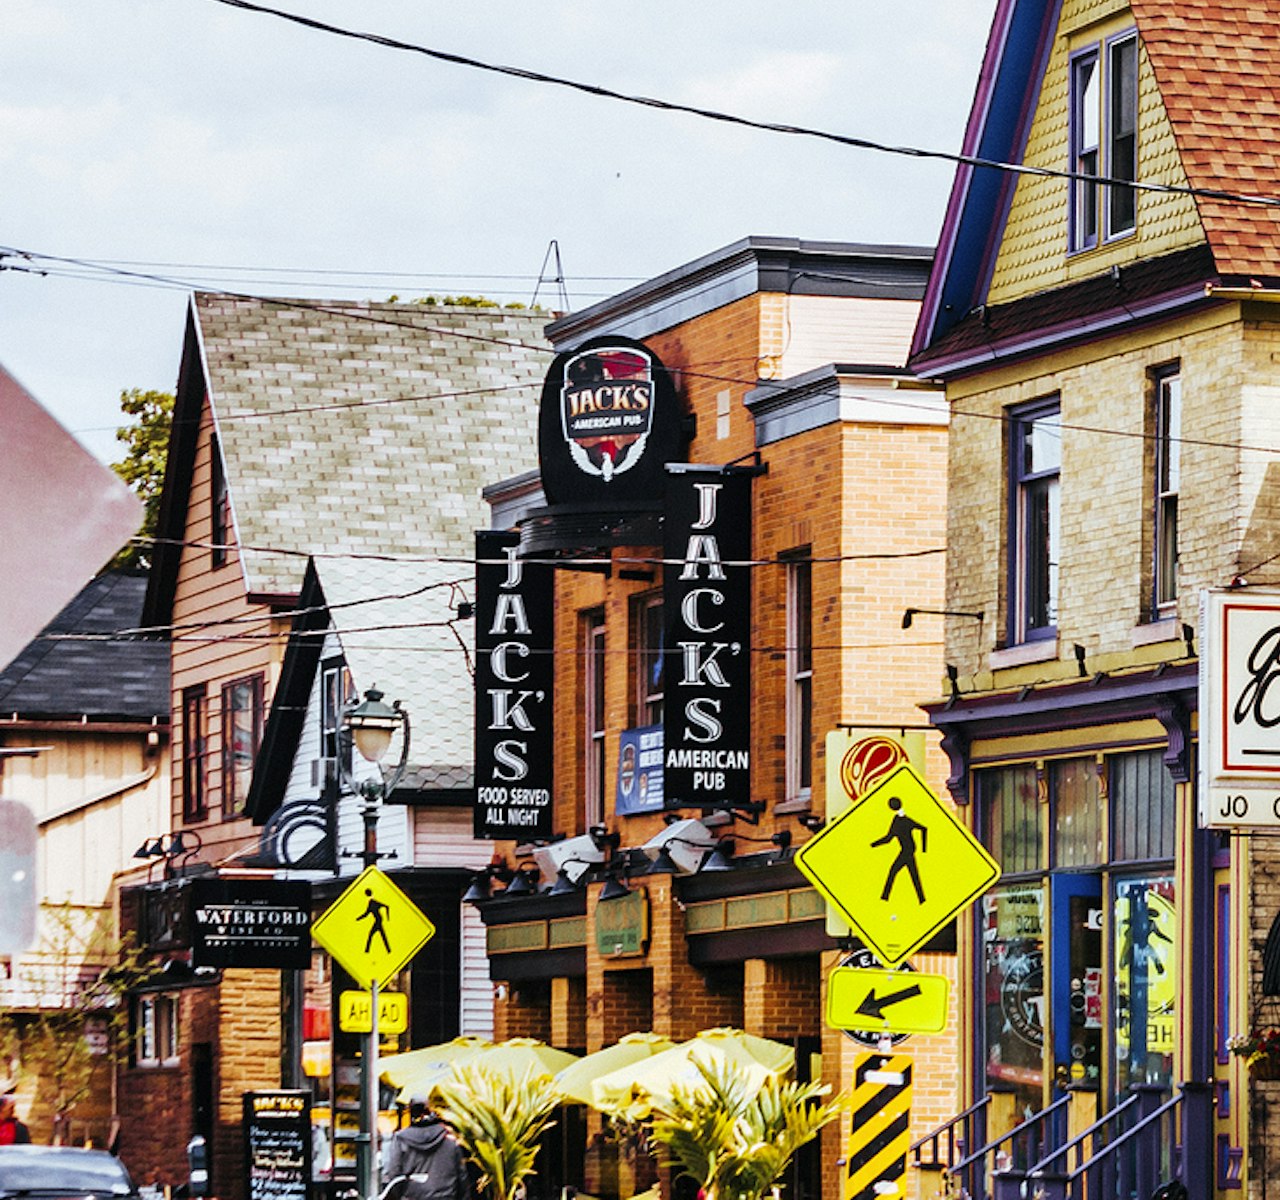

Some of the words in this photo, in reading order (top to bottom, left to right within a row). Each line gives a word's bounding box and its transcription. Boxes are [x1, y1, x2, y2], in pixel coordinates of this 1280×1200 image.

[568, 384, 650, 417] JACK'S
[677, 482, 742, 744] JACK'S
[487, 546, 545, 783] JACK'S
[666, 749, 749, 770] AMERICAN
[693, 771, 726, 791] PUB
[477, 786, 508, 805] FOOD
[510, 788, 550, 806] SERVED
[485, 807, 505, 825] ALL
[507, 808, 539, 826] NIGHT
[1220, 796, 1249, 818] JO
[196, 909, 308, 925] WATERFORD
[348, 1002, 401, 1023] AHAD
